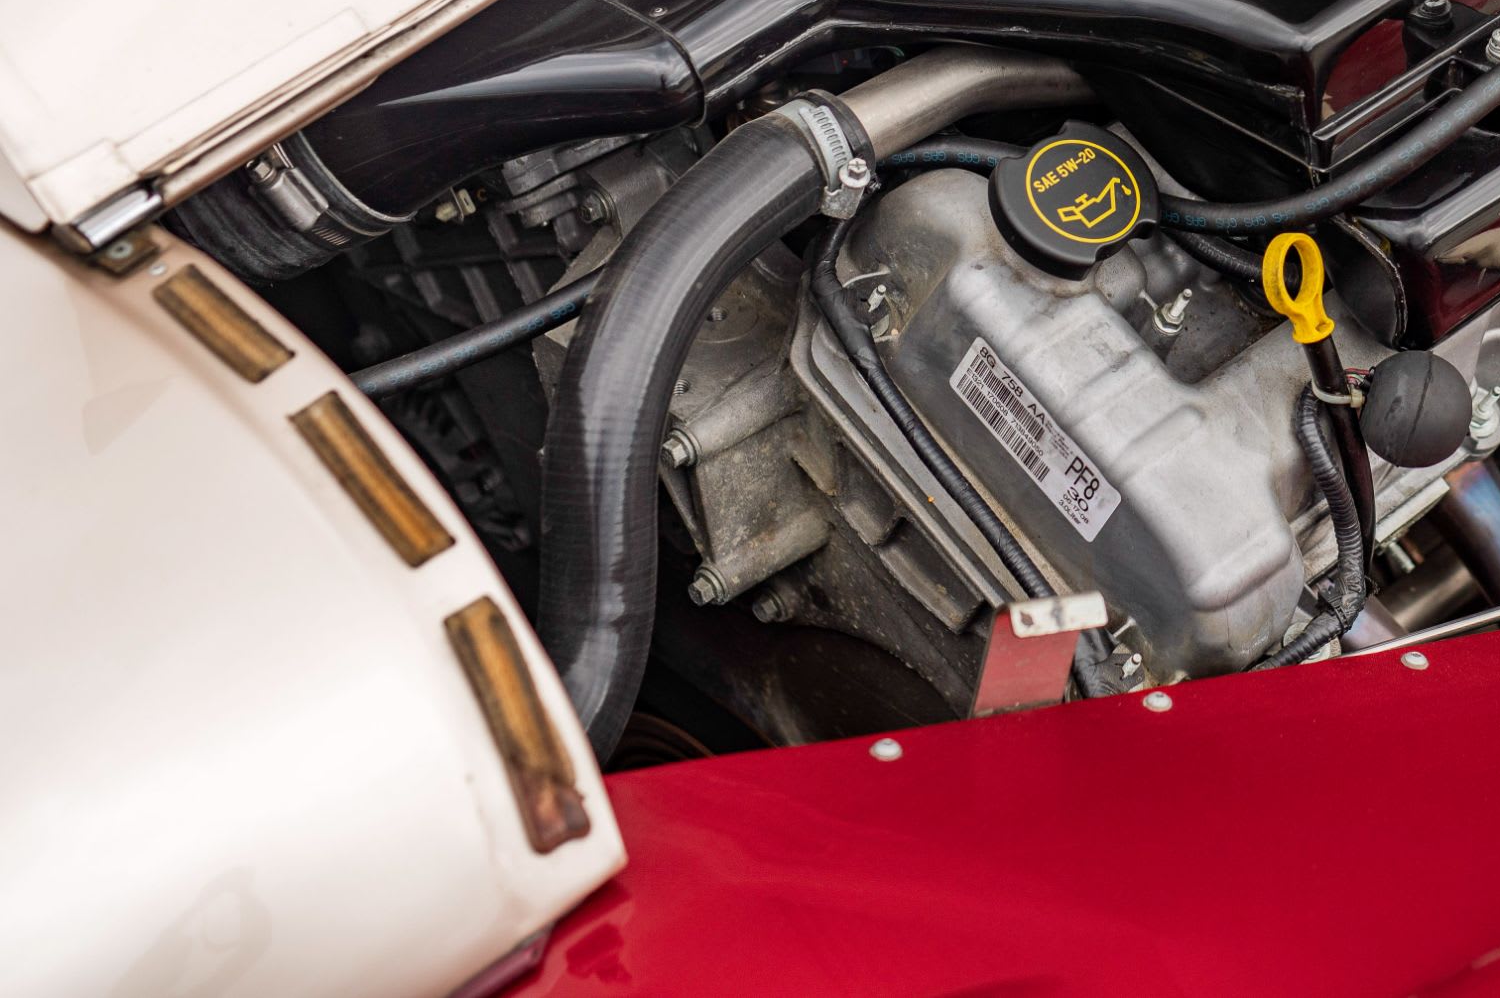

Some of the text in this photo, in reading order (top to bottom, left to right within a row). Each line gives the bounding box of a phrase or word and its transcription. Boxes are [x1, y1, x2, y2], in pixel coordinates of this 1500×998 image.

[1033, 147, 1096, 193] SAE 5W-20
[979, 346, 1046, 425] 8G 758 AA
[1064, 455, 1100, 500] PF8
[1067, 486, 1089, 512] 30
